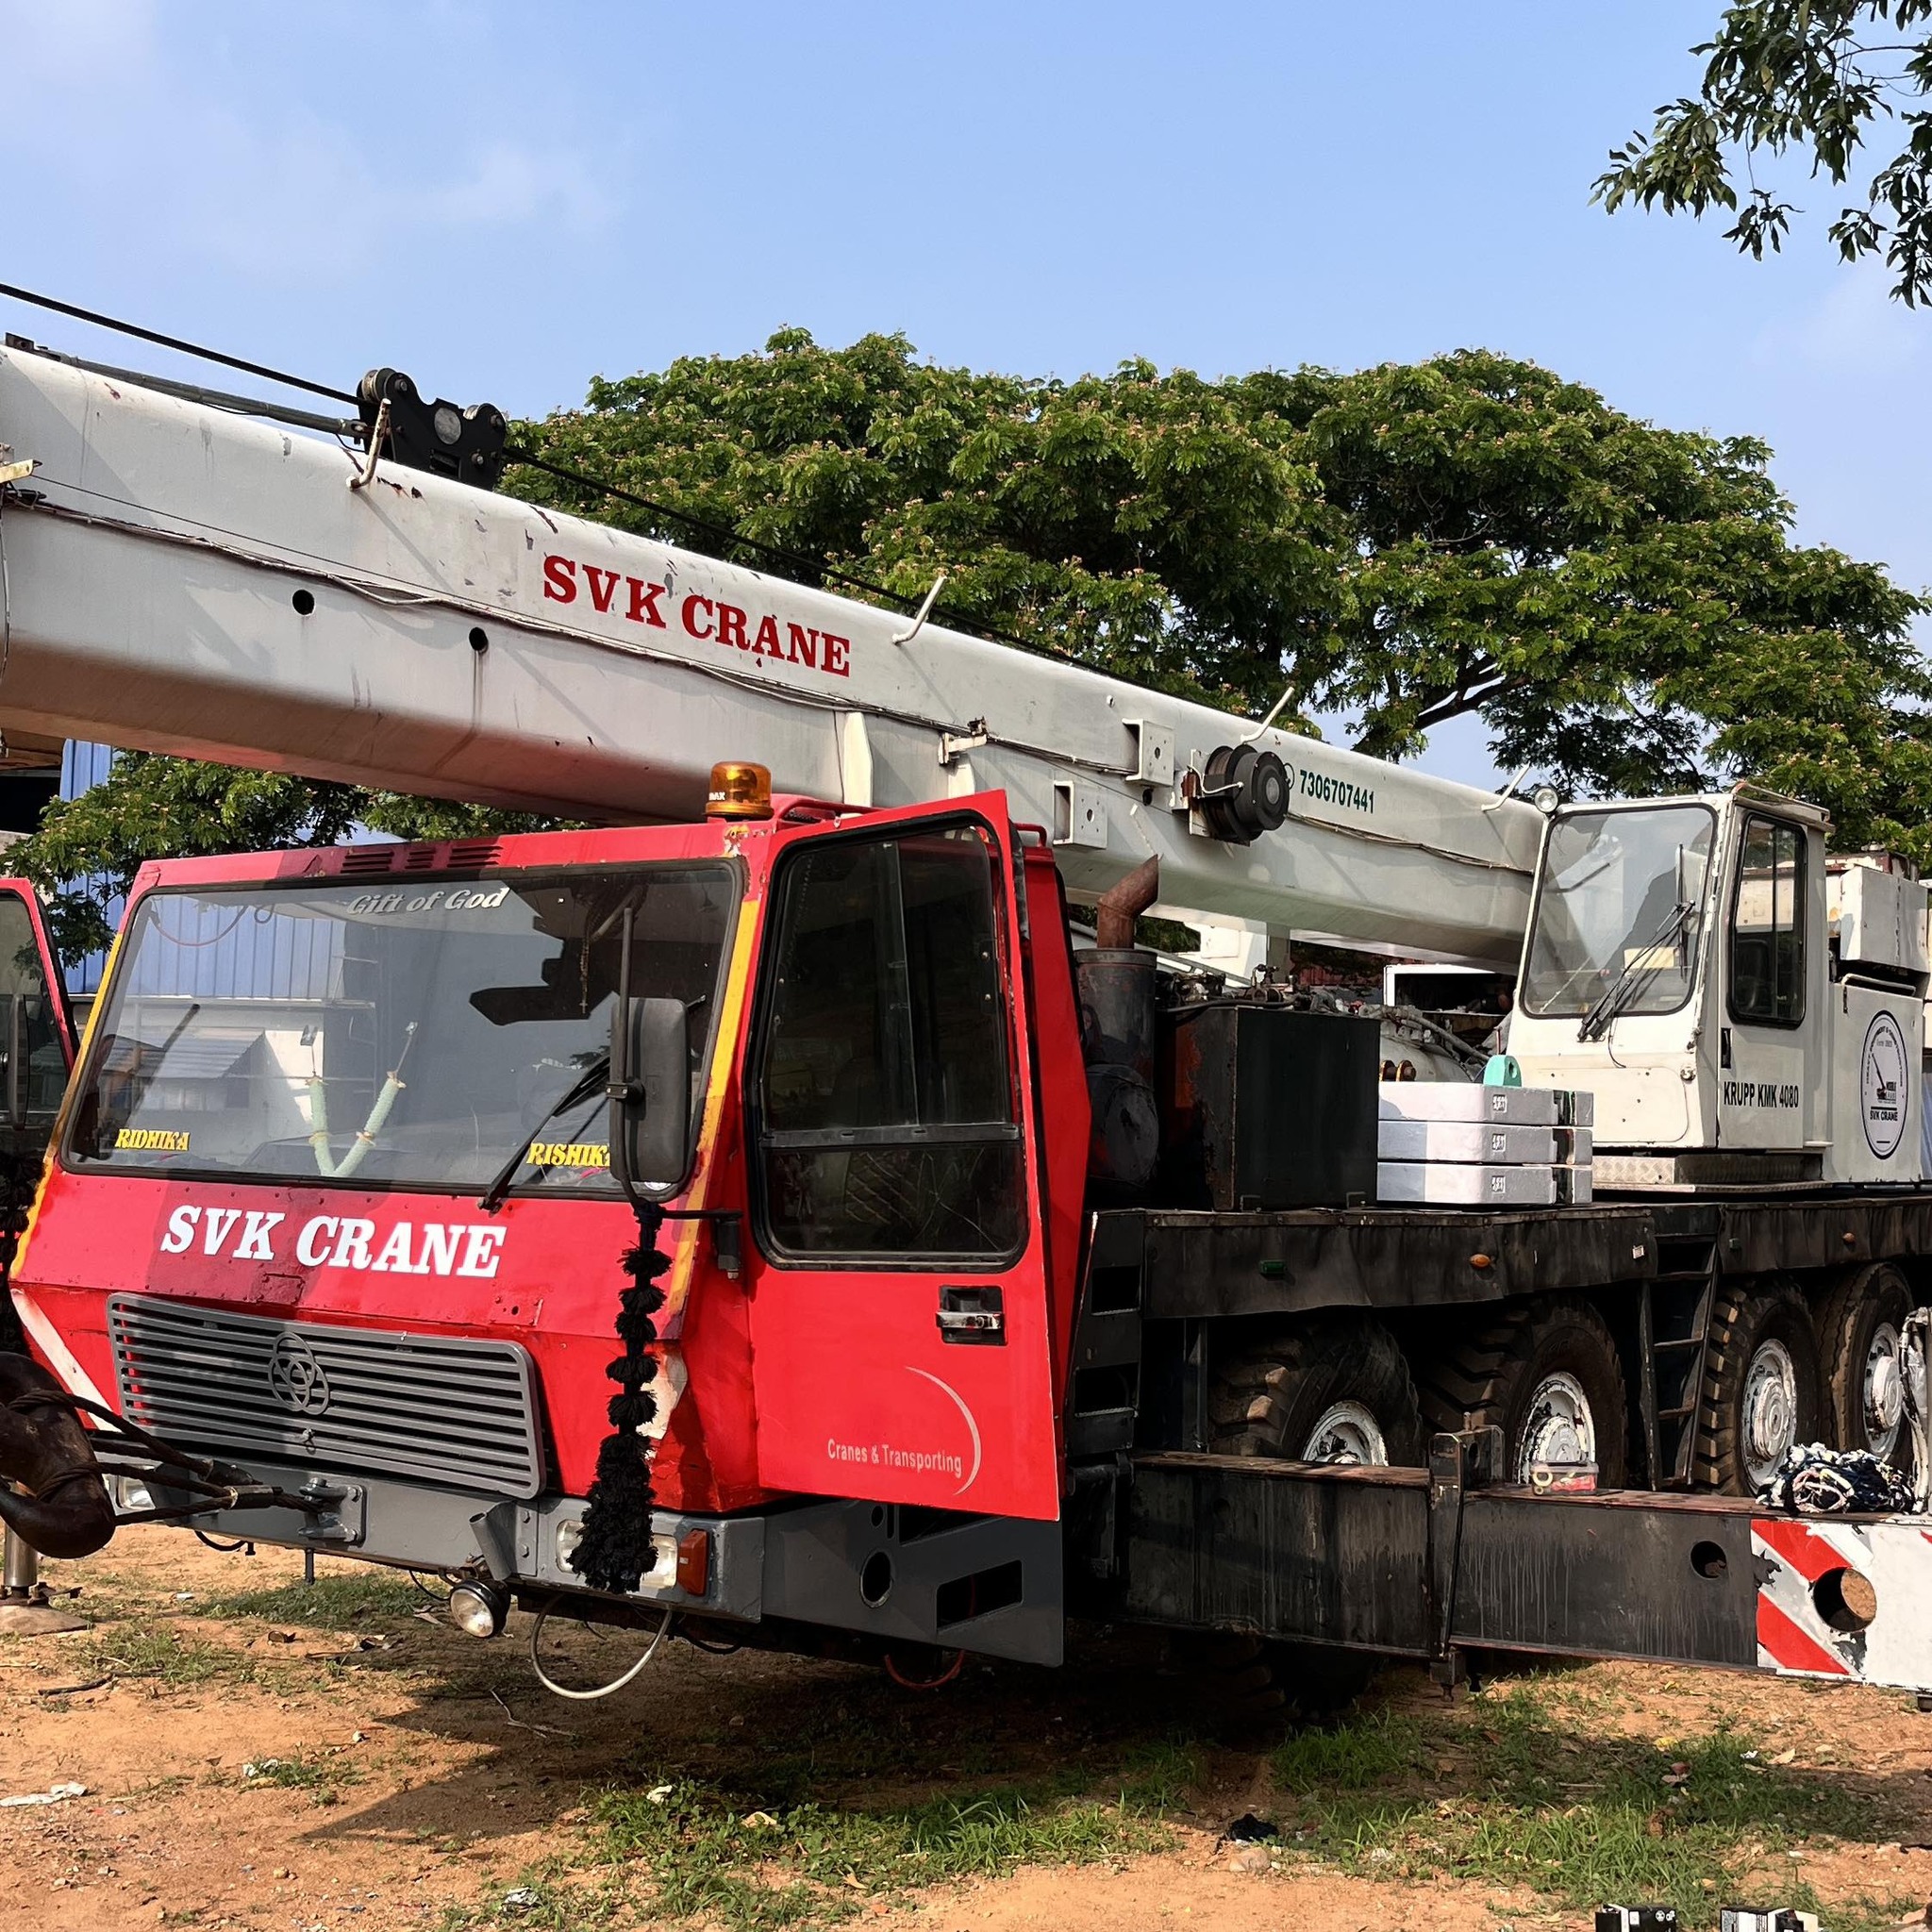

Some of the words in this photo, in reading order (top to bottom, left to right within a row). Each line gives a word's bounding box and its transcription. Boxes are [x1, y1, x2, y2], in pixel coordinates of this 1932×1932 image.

[544, 555, 666, 628] SVK
[681, 594, 850, 677] CRANE
[1300, 769, 1374, 814] 7306707441
[346, 894, 405, 915] Gift
[406, 891, 445, 912] of
[444, 887, 510, 910] God
[1724, 1081, 1755, 1107] KRUPP
[1757, 1083, 1777, 1108] KMK
[1779, 1084, 1799, 1108] 4080
[1870, 1110, 1880, 1121] SVK
[1880, 1111, 1898, 1121] CRANE
[114, 1128, 191, 1151] RIDHIKA
[160, 1204, 286, 1261] SVK
[295, 1214, 508, 1278] CRANE
[827, 1438, 868, 1463] Cranes
[871, 1444, 879, 1464] &
[881, 1443, 962, 1479] Transporting
